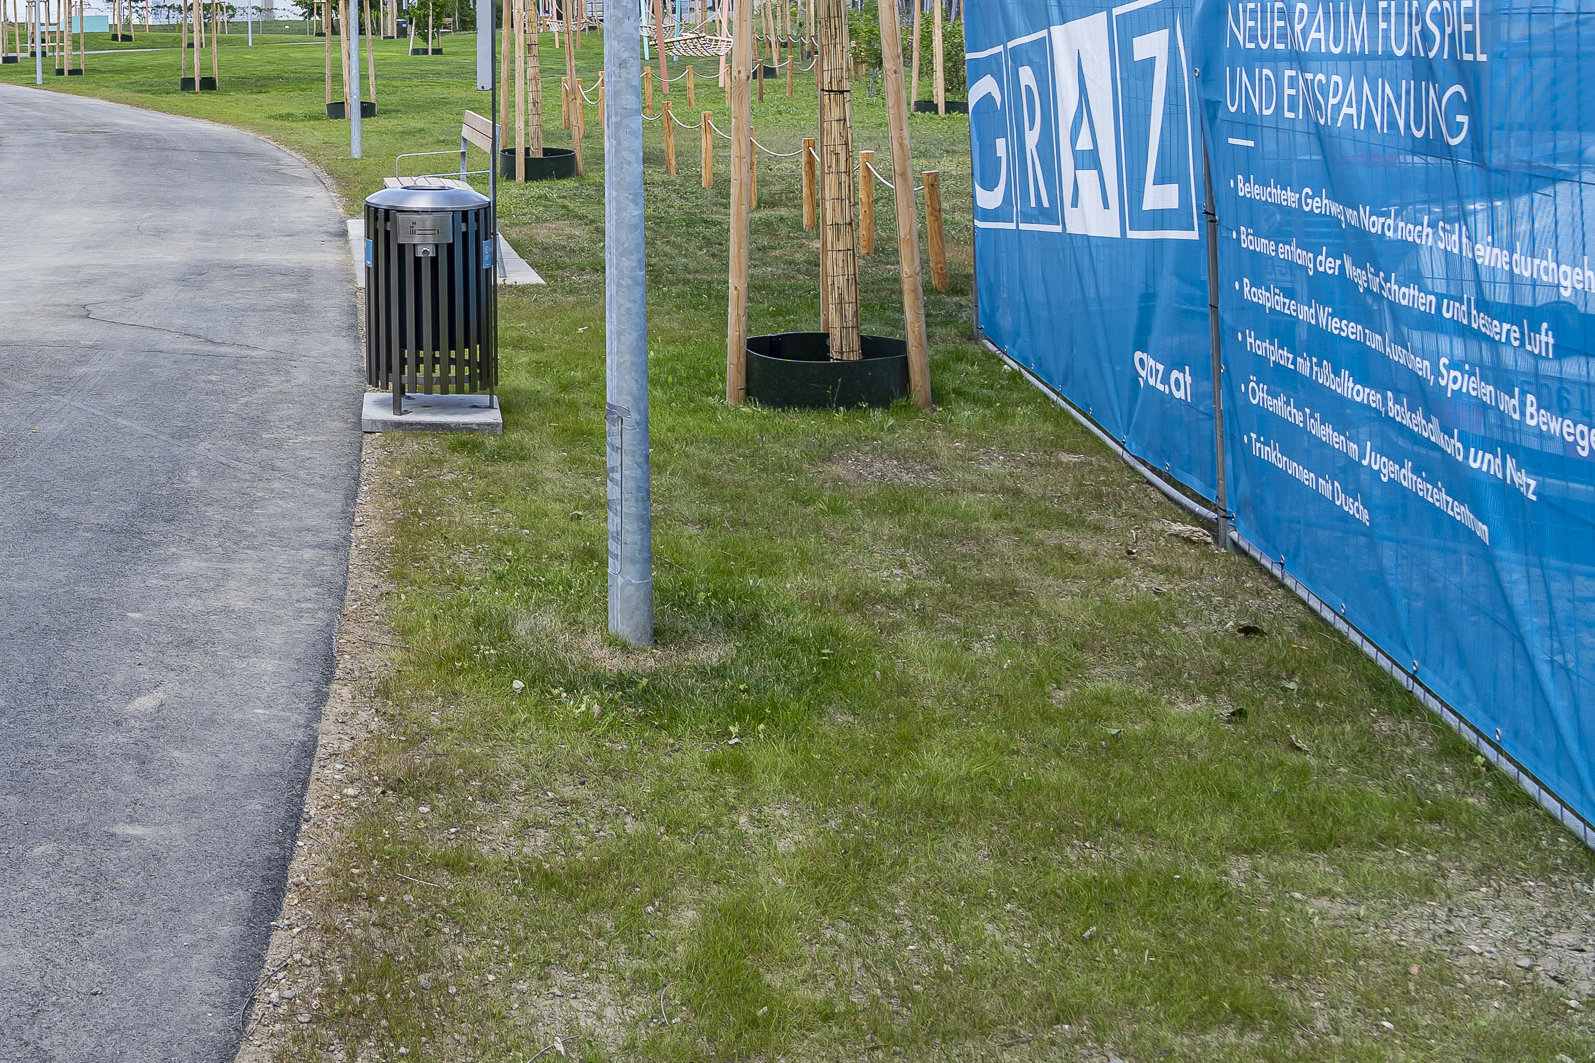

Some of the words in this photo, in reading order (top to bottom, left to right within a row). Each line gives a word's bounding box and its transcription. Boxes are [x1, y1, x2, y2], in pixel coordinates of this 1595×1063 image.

[1293, 0, 1369, 56] RAUM
[1425, 0, 1488, 62] SPIEL
[968, 28, 1179, 210] GRAZ
[1226, 66, 1276, 116] UND
[1283, 69, 1469, 146] ENTSPANNUNG
[1237, 174, 1299, 209] Beleuchteter
[1301, 187, 1346, 229] Gehweg
[1344, 206, 1360, 227] von
[1359, 204, 1395, 237] Nord
[1398, 215, 1433, 246] nach
[1438, 221, 1459, 254] Süd
[1474, 235, 1510, 271] eine
[1512, 241, 1595, 297] durchgeh
[1240, 225, 1276, 257] Bäume
[1278, 238, 1314, 276] entlang
[1316, 246, 1342, 275] der
[1343, 253, 1367, 293] Wege
[1367, 262, 1380, 294] für
[1380, 271, 1436, 315] Schatten
[1442, 293, 1468, 325] und
[1471, 296, 1521, 347] bessere
[1523, 319, 1554, 359] Luft
[1243, 277, 1297, 317] Rastplätze
[1297, 299, 1316, 325] und
[1316, 303, 1364, 343] Wiesen
[1364, 328, 1385, 354] zum
[1438, 356, 1495, 406] Spielen
[1496, 387, 1521, 421] und
[1245, 329, 1295, 369] Hartplatz
[1296, 352, 1310, 377] mit
[1312, 356, 1386, 417] Fußballtoren,
[1387, 390, 1464, 462] Basketballkorb
[1469, 446, 1503, 480] und
[1506, 453, 1538, 501] Netz
[1248, 375, 1304, 428] Öffentliche
[1304, 407, 1347, 454] Toiletten
[1346, 431, 1359, 462] im
[1362, 441, 1490, 546] Jugendfreizeitzentrum
[1250, 432, 1316, 490] Trinkbrunnen
[1318, 474, 1333, 502] mit
[1334, 480, 1370, 527] Dusche
